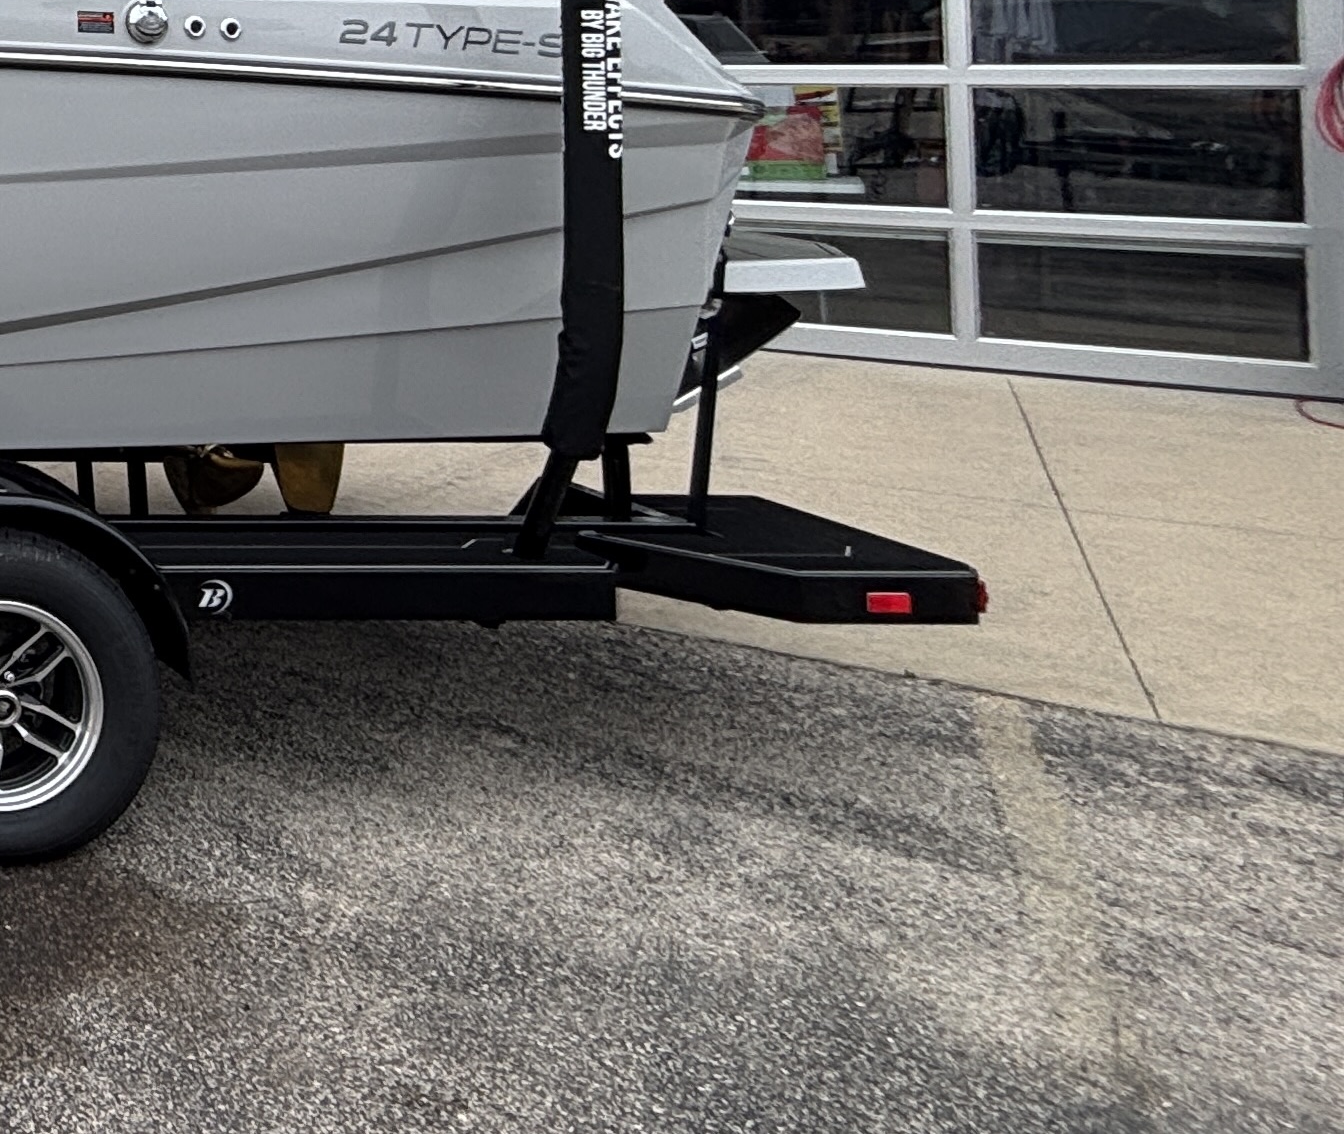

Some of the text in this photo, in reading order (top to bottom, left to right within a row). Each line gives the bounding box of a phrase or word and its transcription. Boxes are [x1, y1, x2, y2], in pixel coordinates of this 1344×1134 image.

[580, 9, 608, 131] BY BIG THUNDER
